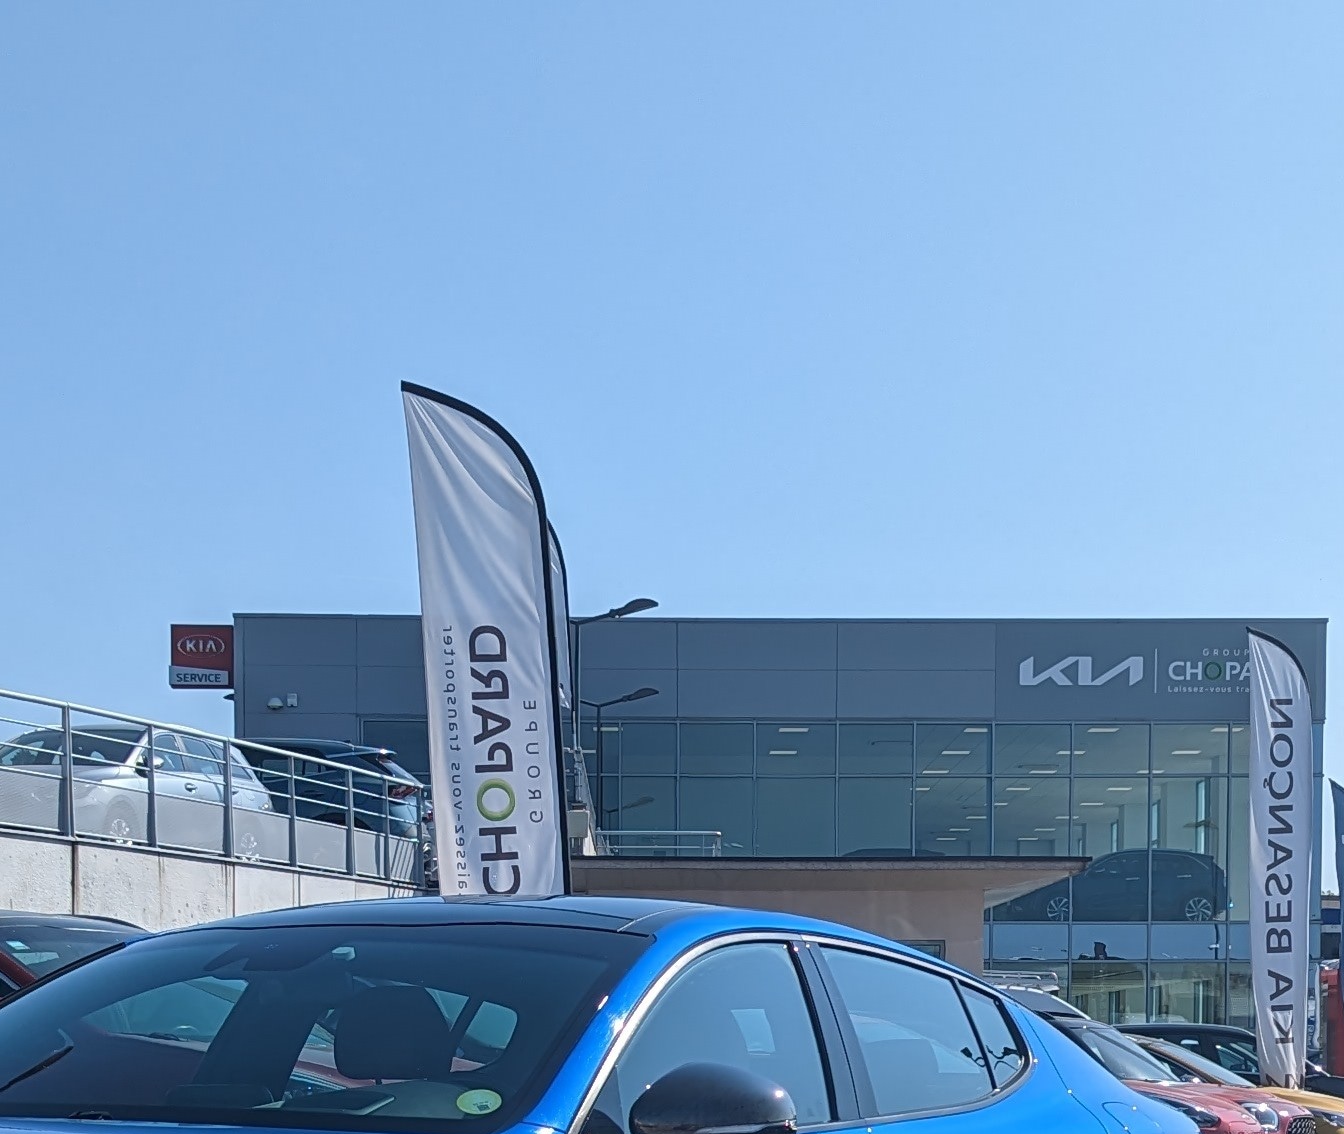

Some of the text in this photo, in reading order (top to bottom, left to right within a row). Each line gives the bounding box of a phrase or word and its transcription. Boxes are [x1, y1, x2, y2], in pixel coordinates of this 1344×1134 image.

[1202, 648, 1250, 656] GROUP
[1168, 661, 1251, 681] CHOPA
[176, 673, 222, 682] SERVICE
